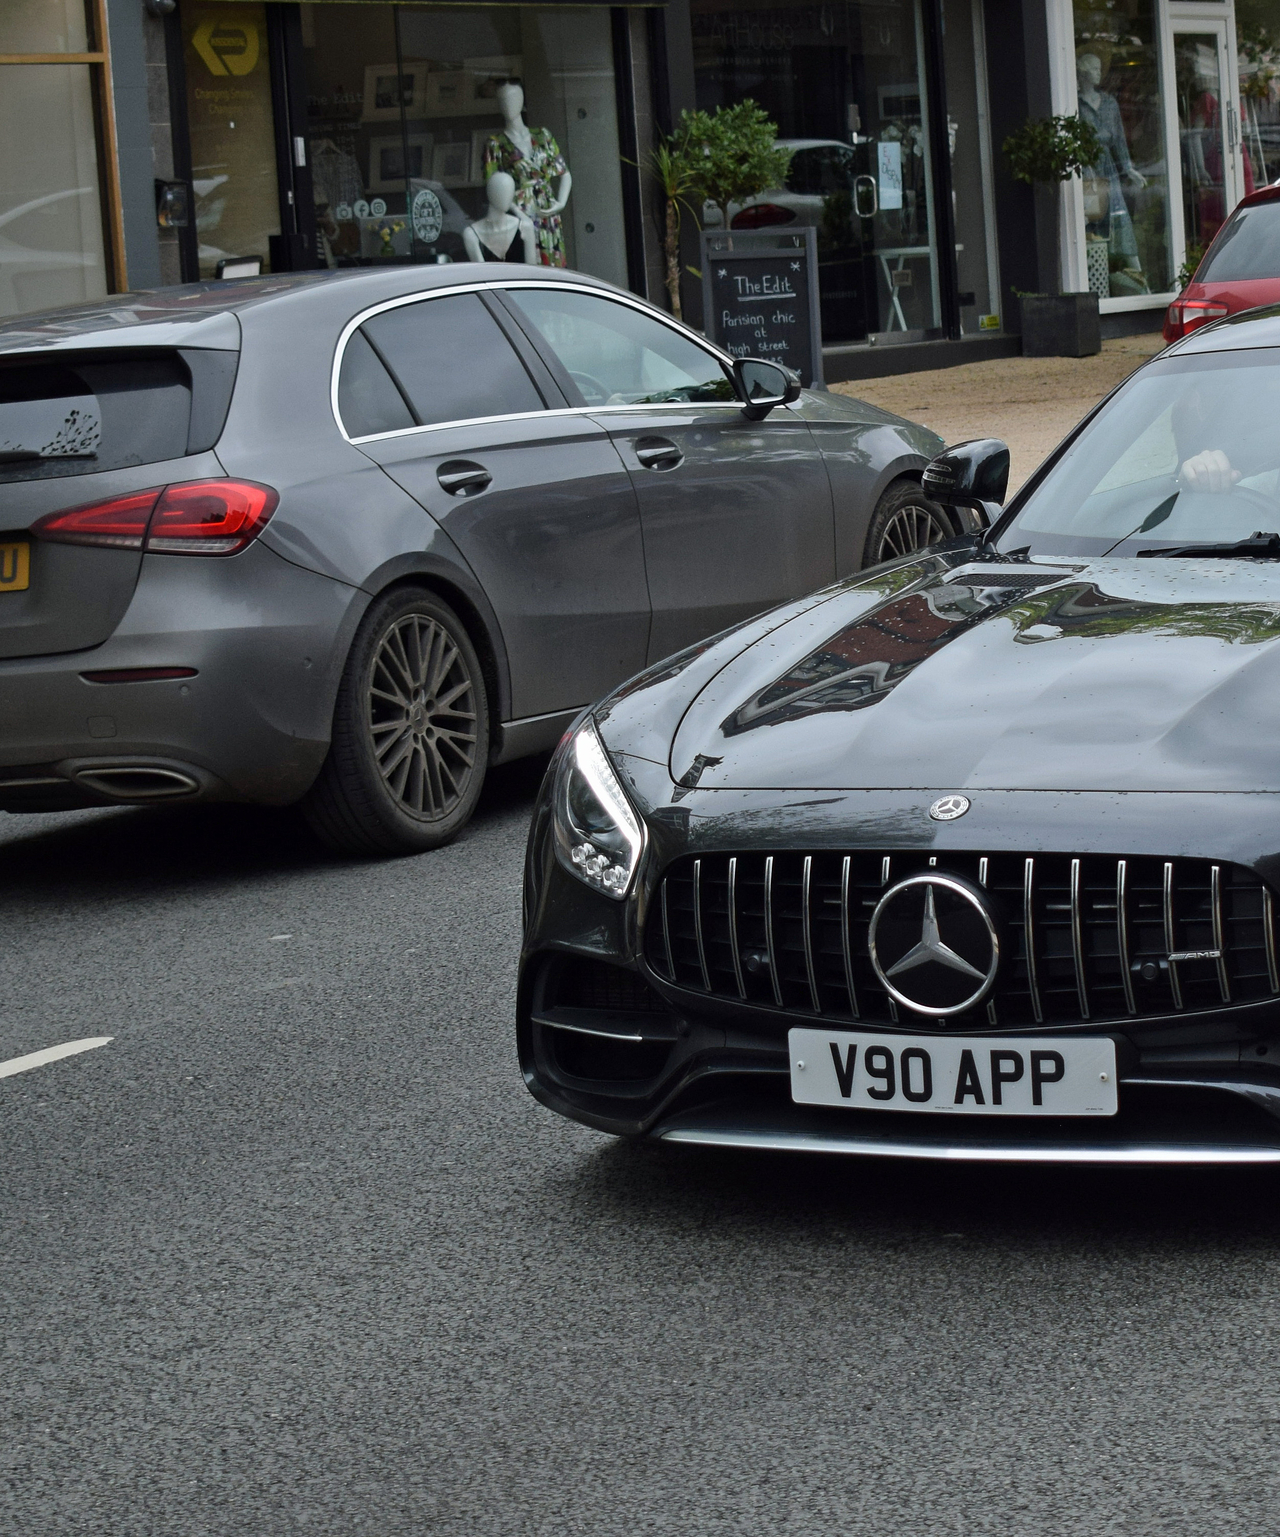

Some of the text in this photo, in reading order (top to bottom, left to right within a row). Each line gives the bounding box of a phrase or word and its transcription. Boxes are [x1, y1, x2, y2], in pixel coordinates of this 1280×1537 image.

[733, 275, 793, 294] The Edit
[722, 310, 796, 328] Parisian chic
[754, 327, 768, 338] at
[727, 340, 790, 358] high street
[1184, 950, 1221, 960] AMG
[829, 1042, 1066, 1106] V90 APP
